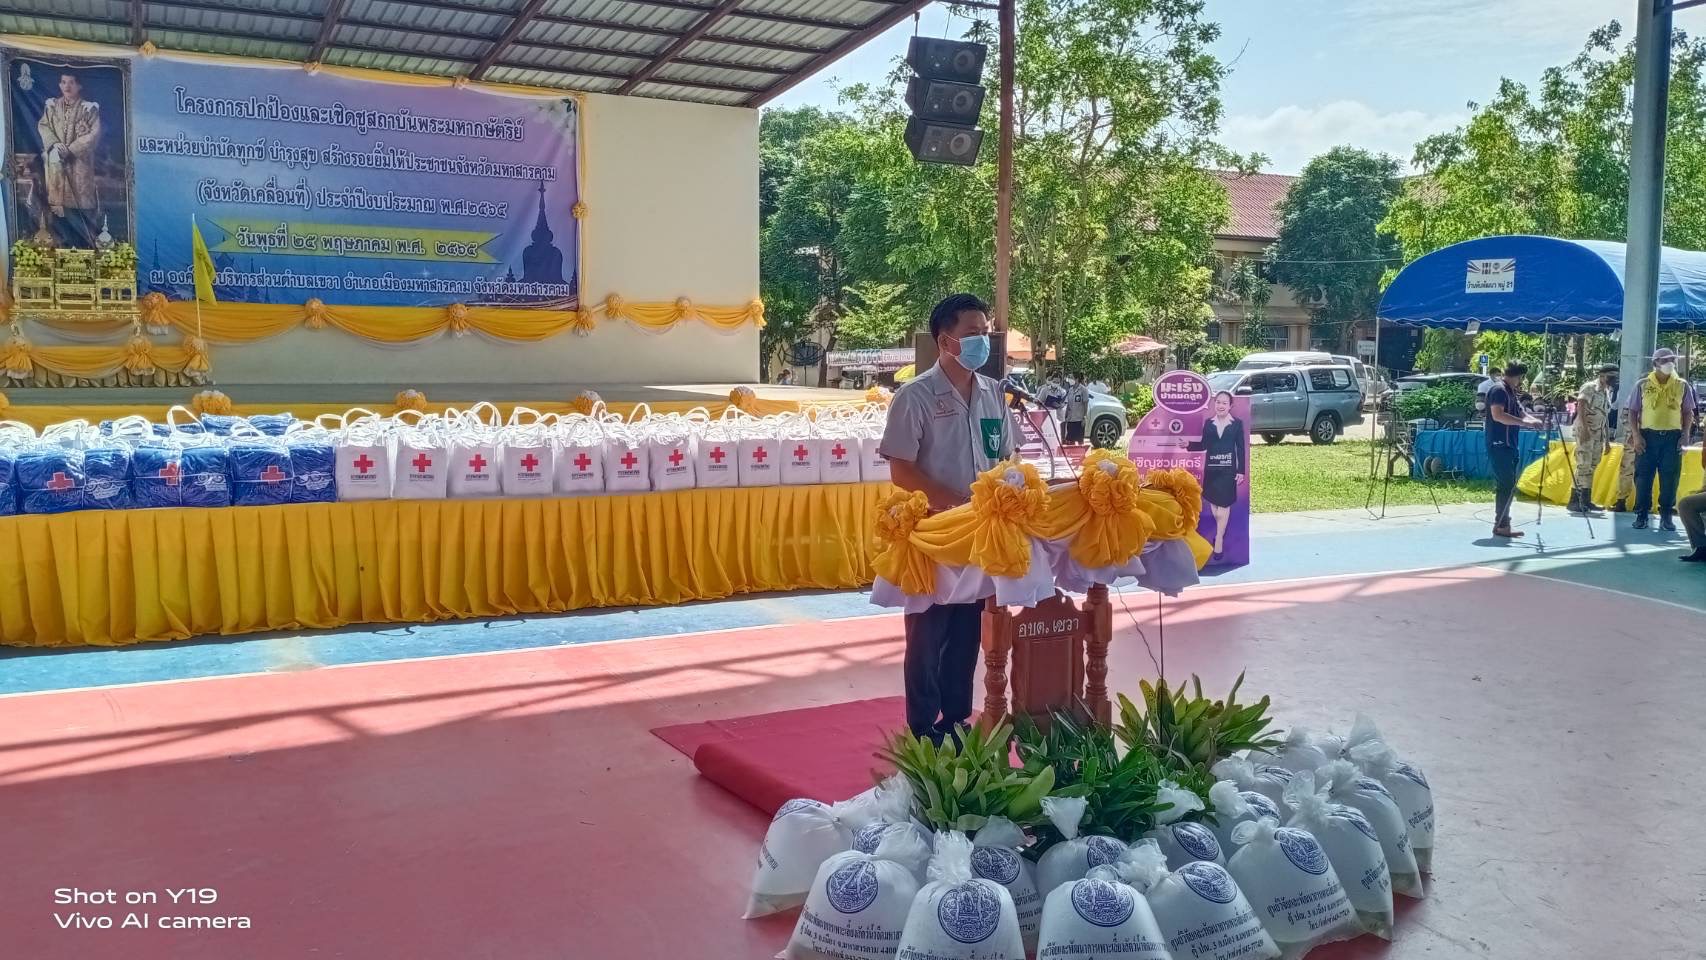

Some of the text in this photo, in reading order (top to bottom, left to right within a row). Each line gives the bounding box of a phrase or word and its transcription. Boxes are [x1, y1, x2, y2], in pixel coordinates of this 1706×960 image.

[174, 86, 524, 141] โครงการปกป้องและเชิดชูสถาบันพระมหากษัตริย์
[138, 133, 556, 181] และหน่วยบำบัดทุกข์ บำรุงสุข สร้างรอยยิ้มให้ประชาชนจังหวัดมหาสารคาม
[197, 176, 313, 209] (จังหวัดเคลื่อนที่)
[316, 186, 436, 214] ประจำปีงบประมาณ
[236, 223, 479, 257] วันพุธที่ ๒๕ พฤษภาคม พ.ศ. ๒๕๖๕
[150, 269, 164, 285] ณ
[343, 271, 471, 294] อำเภอเมืองมหาสารคาม
[473, 276, 569, 297] จังหวัดมหาสารคาม
[1160, 377, 1204, 393] มะเร็ง
[1160, 393, 1203, 401] ปากมดลูก
[1018, 618, 1079, 638] อบต. เขวา
